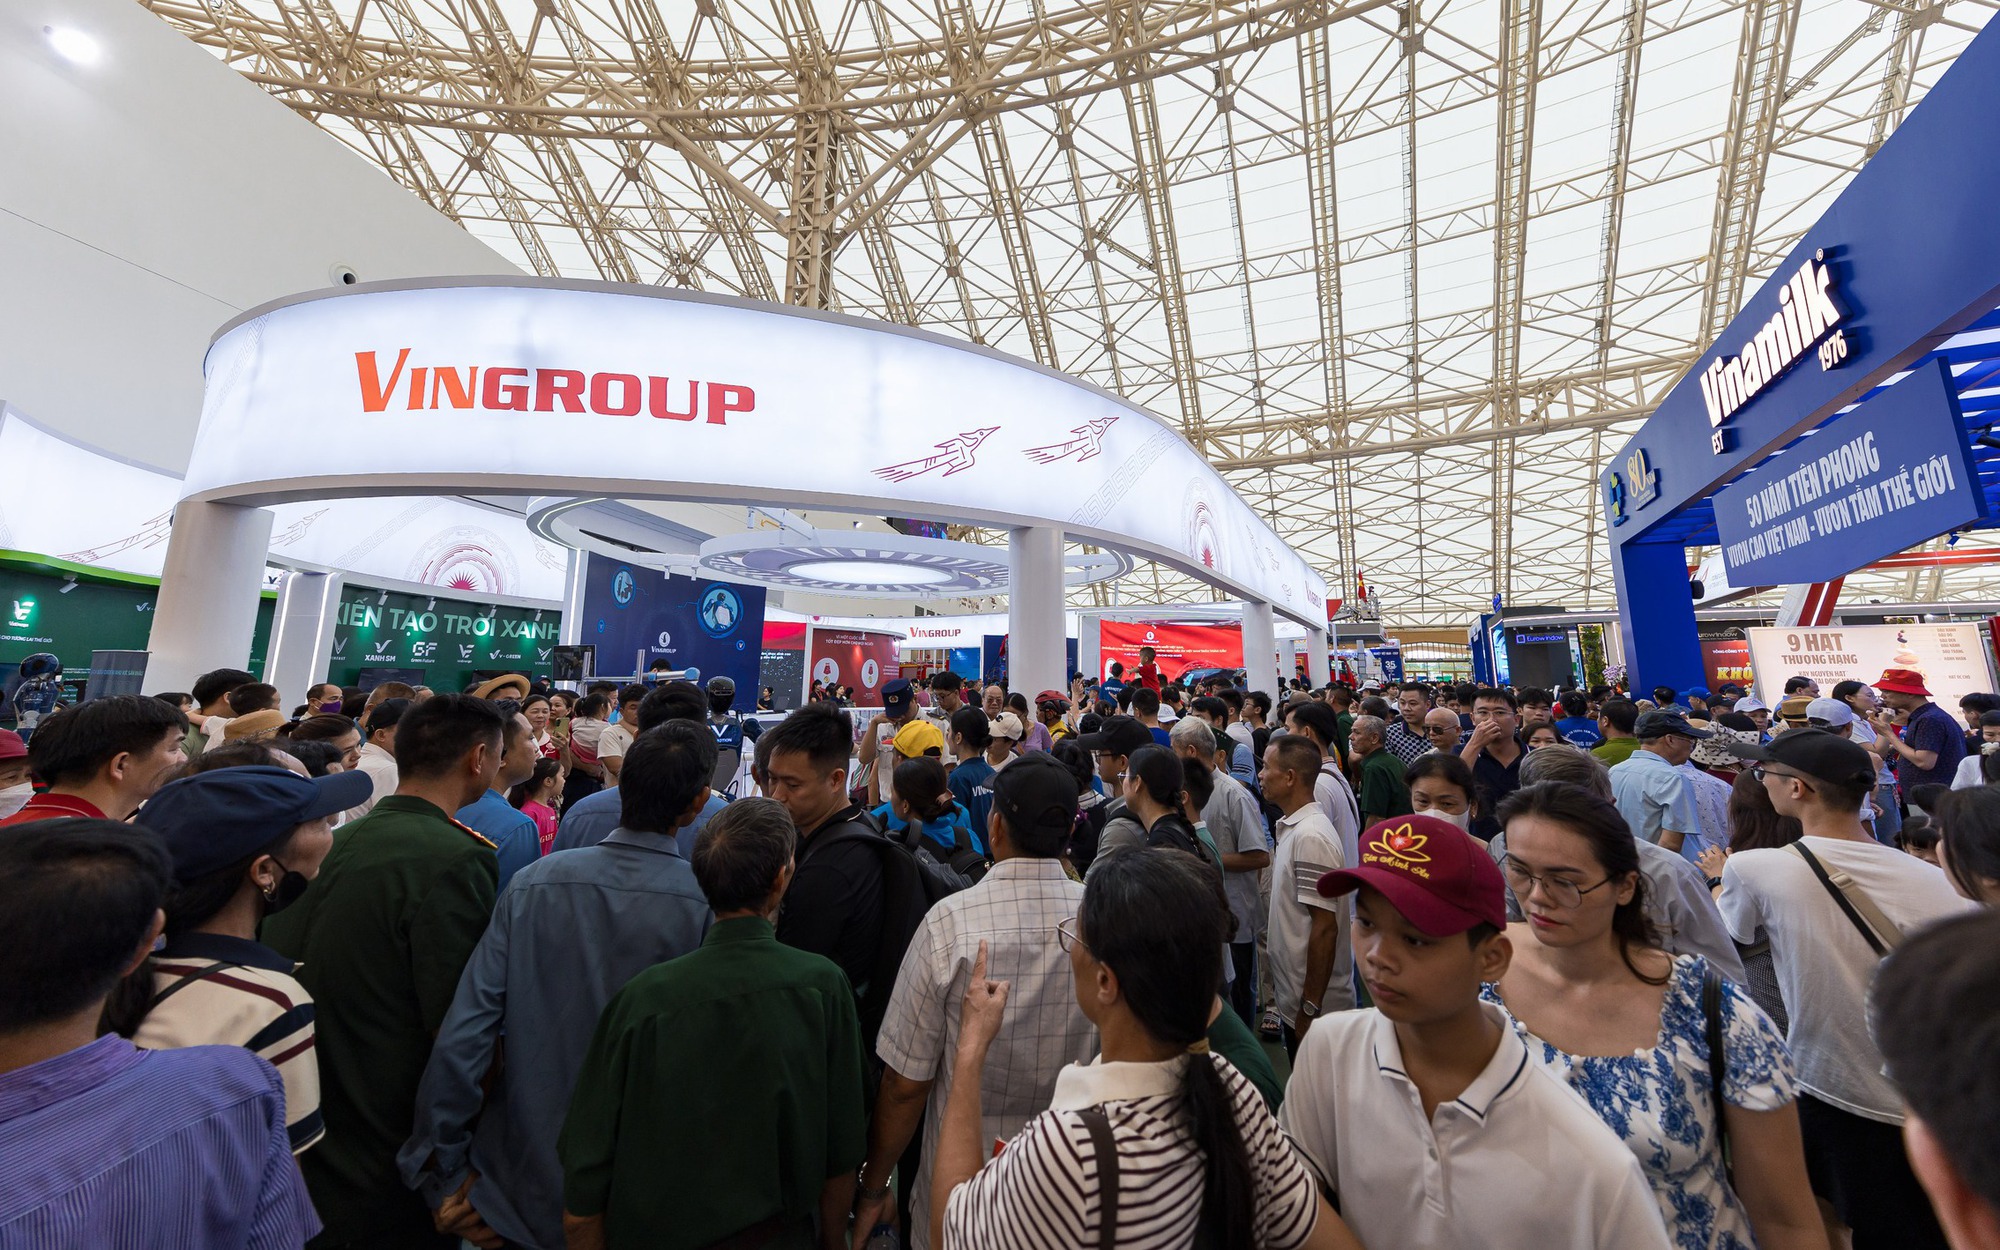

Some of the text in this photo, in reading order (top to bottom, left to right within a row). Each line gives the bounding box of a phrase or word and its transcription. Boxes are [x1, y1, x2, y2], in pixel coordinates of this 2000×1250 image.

[1700, 259, 1840, 428] Vinamilk
[355, 348, 756, 425] VINGROUP
[1711, 329, 1848, 455] EST 1976
[1627, 448, 1646, 497] 80
[1746, 430, 1880, 528] 50 NĂM TIÊN PHONG
[1748, 534, 1766, 561] CAO
[1763, 524, 1786, 555] VIỆT
[1784, 515, 1811, 548] NAM
[1848, 484, 1883, 525] TẦM
[1880, 464, 1916, 512] THẾ
[1913, 454, 1956, 501] GIỚI
[389, 608, 438, 637] TẠO
[443, 612, 496, 637] TRỜI
[500, 619, 561, 640] XANH
[910, 627, 961, 638] VINGROUP
[1787, 633, 1844, 653] 9 HẠT
[364, 654, 385, 662] XANH
[1379, 856, 1409, 870] Minh
